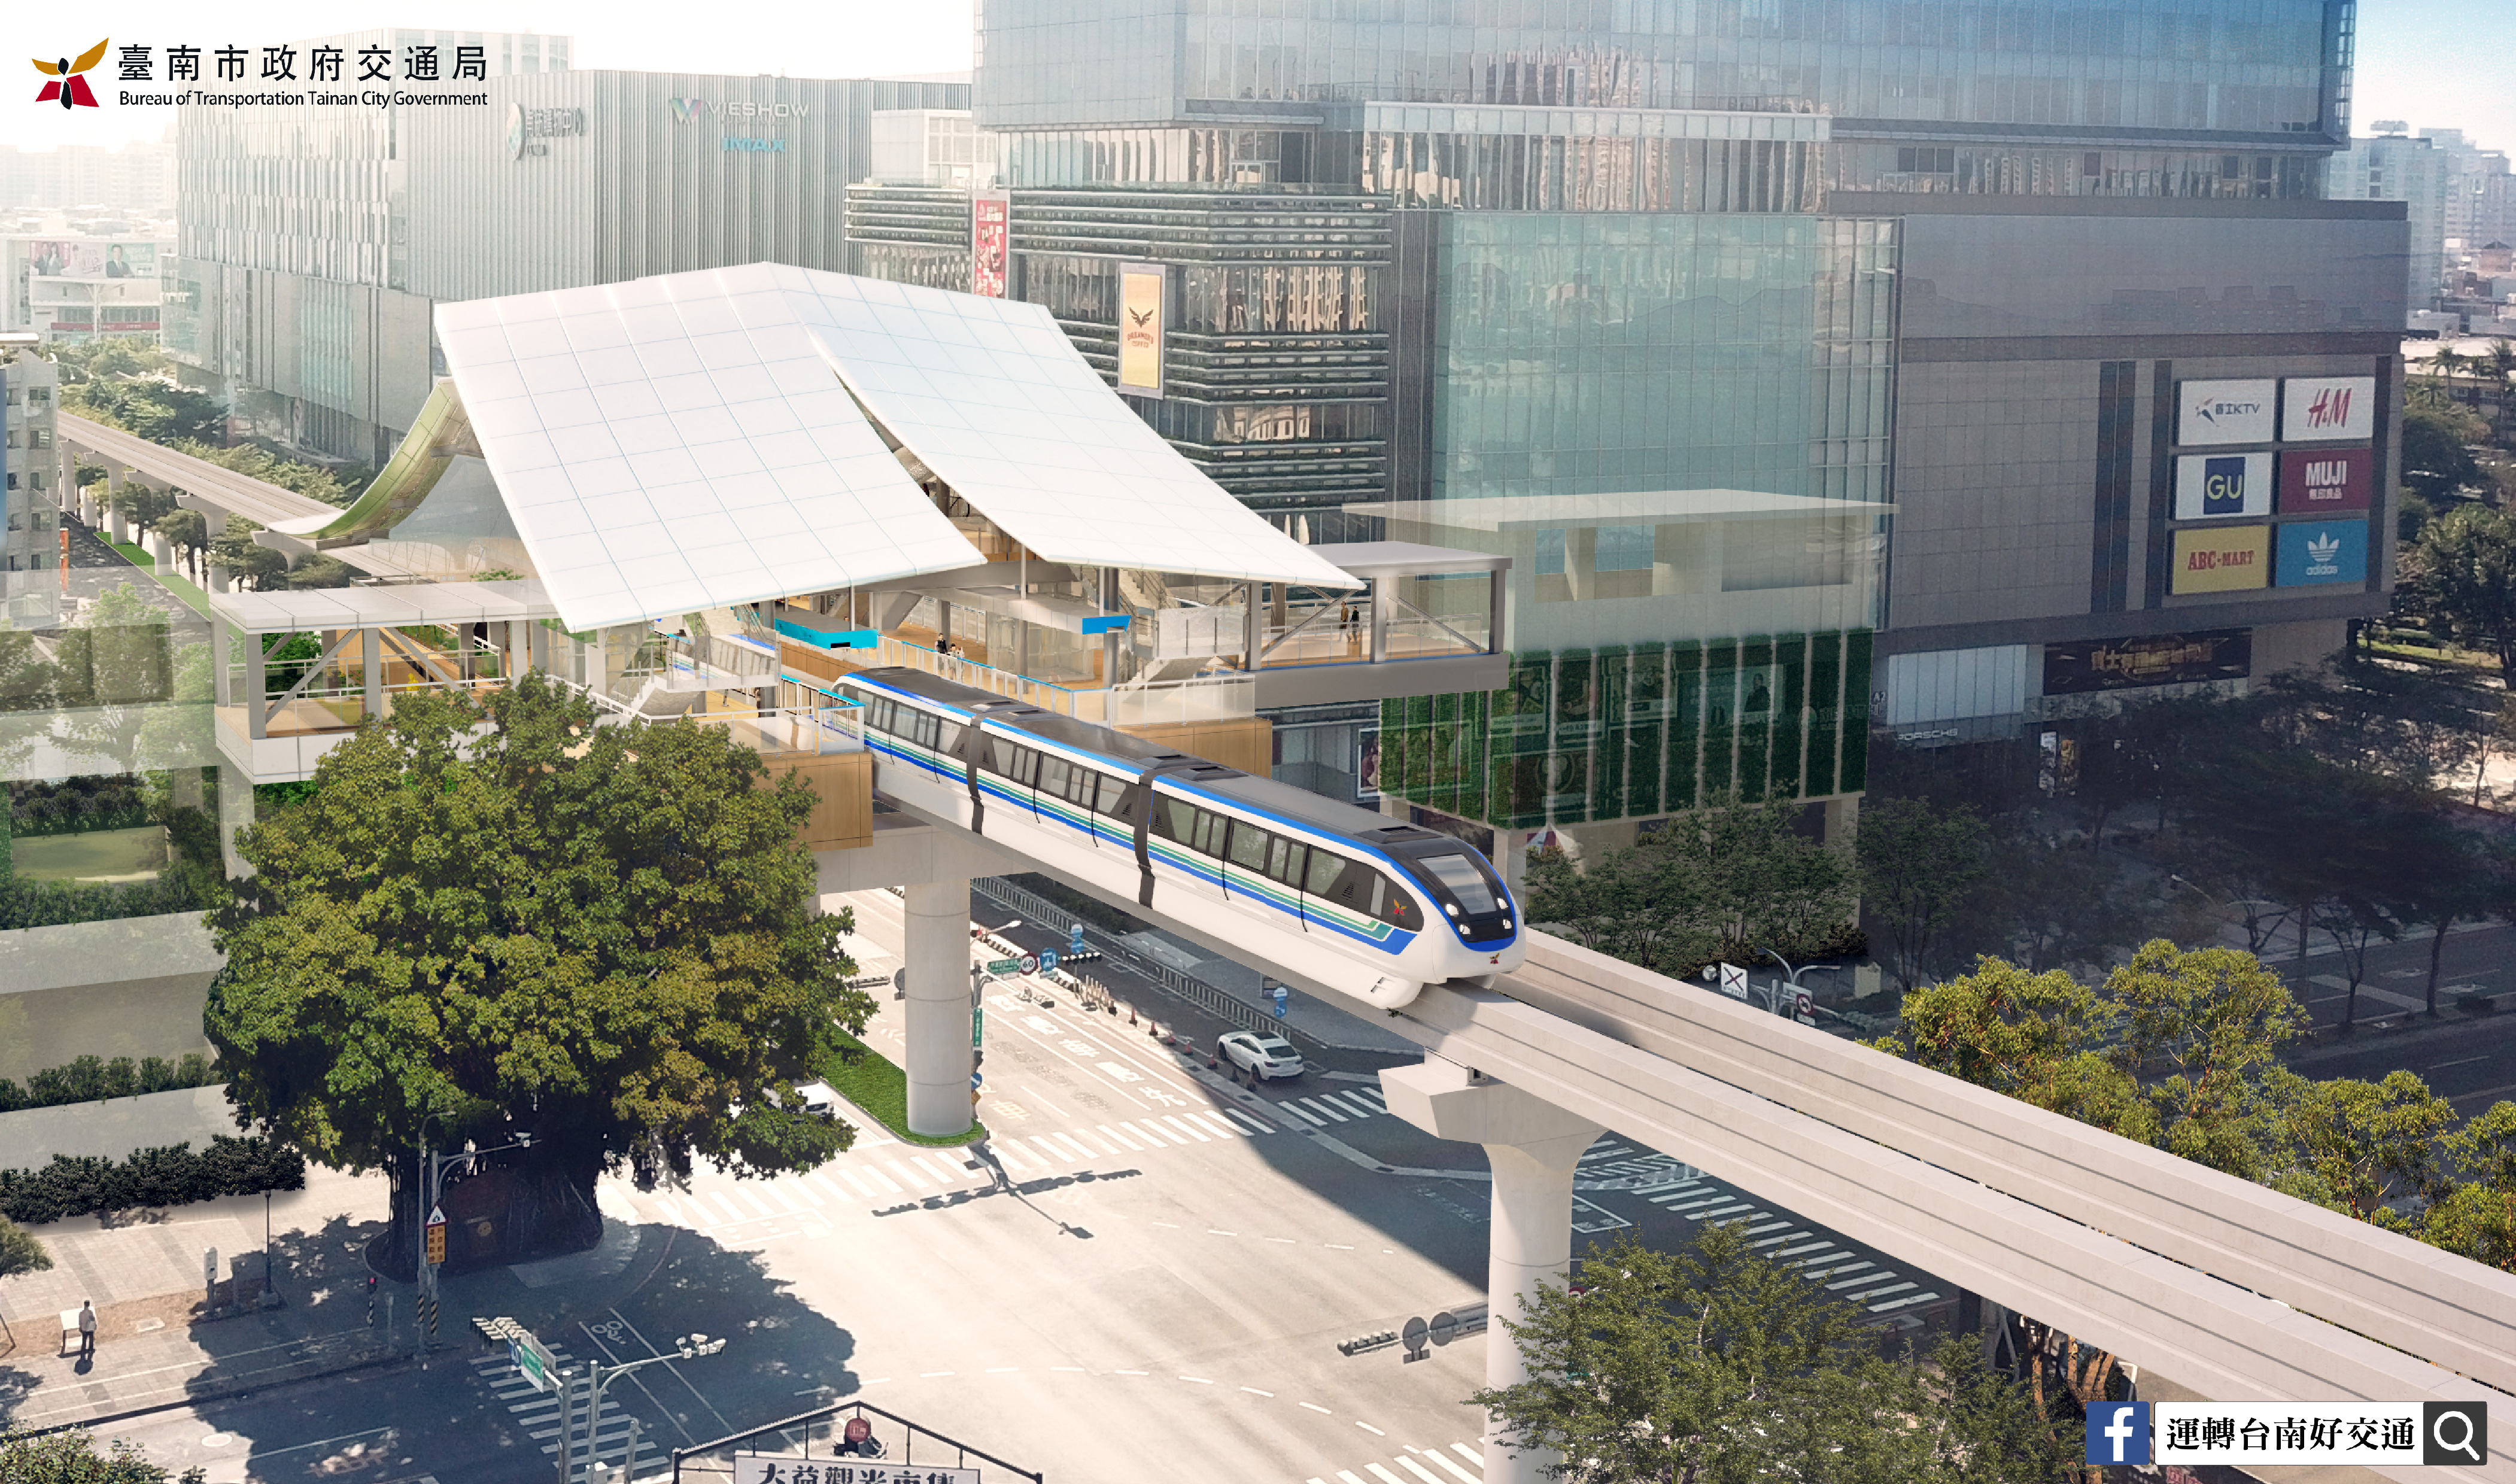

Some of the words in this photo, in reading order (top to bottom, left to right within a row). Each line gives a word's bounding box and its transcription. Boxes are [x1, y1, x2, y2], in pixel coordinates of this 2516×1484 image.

[706, 101, 809, 117] VIESHOW
[722, 137, 786, 152] IMAX
[2307, 388, 2352, 428] H&M
[2305, 460, 2347, 486] MUJI
[2207, 475, 2242, 500] GU
[2188, 550, 2254, 571] ABC-MART
[2306, 564, 2338, 575] adidas
